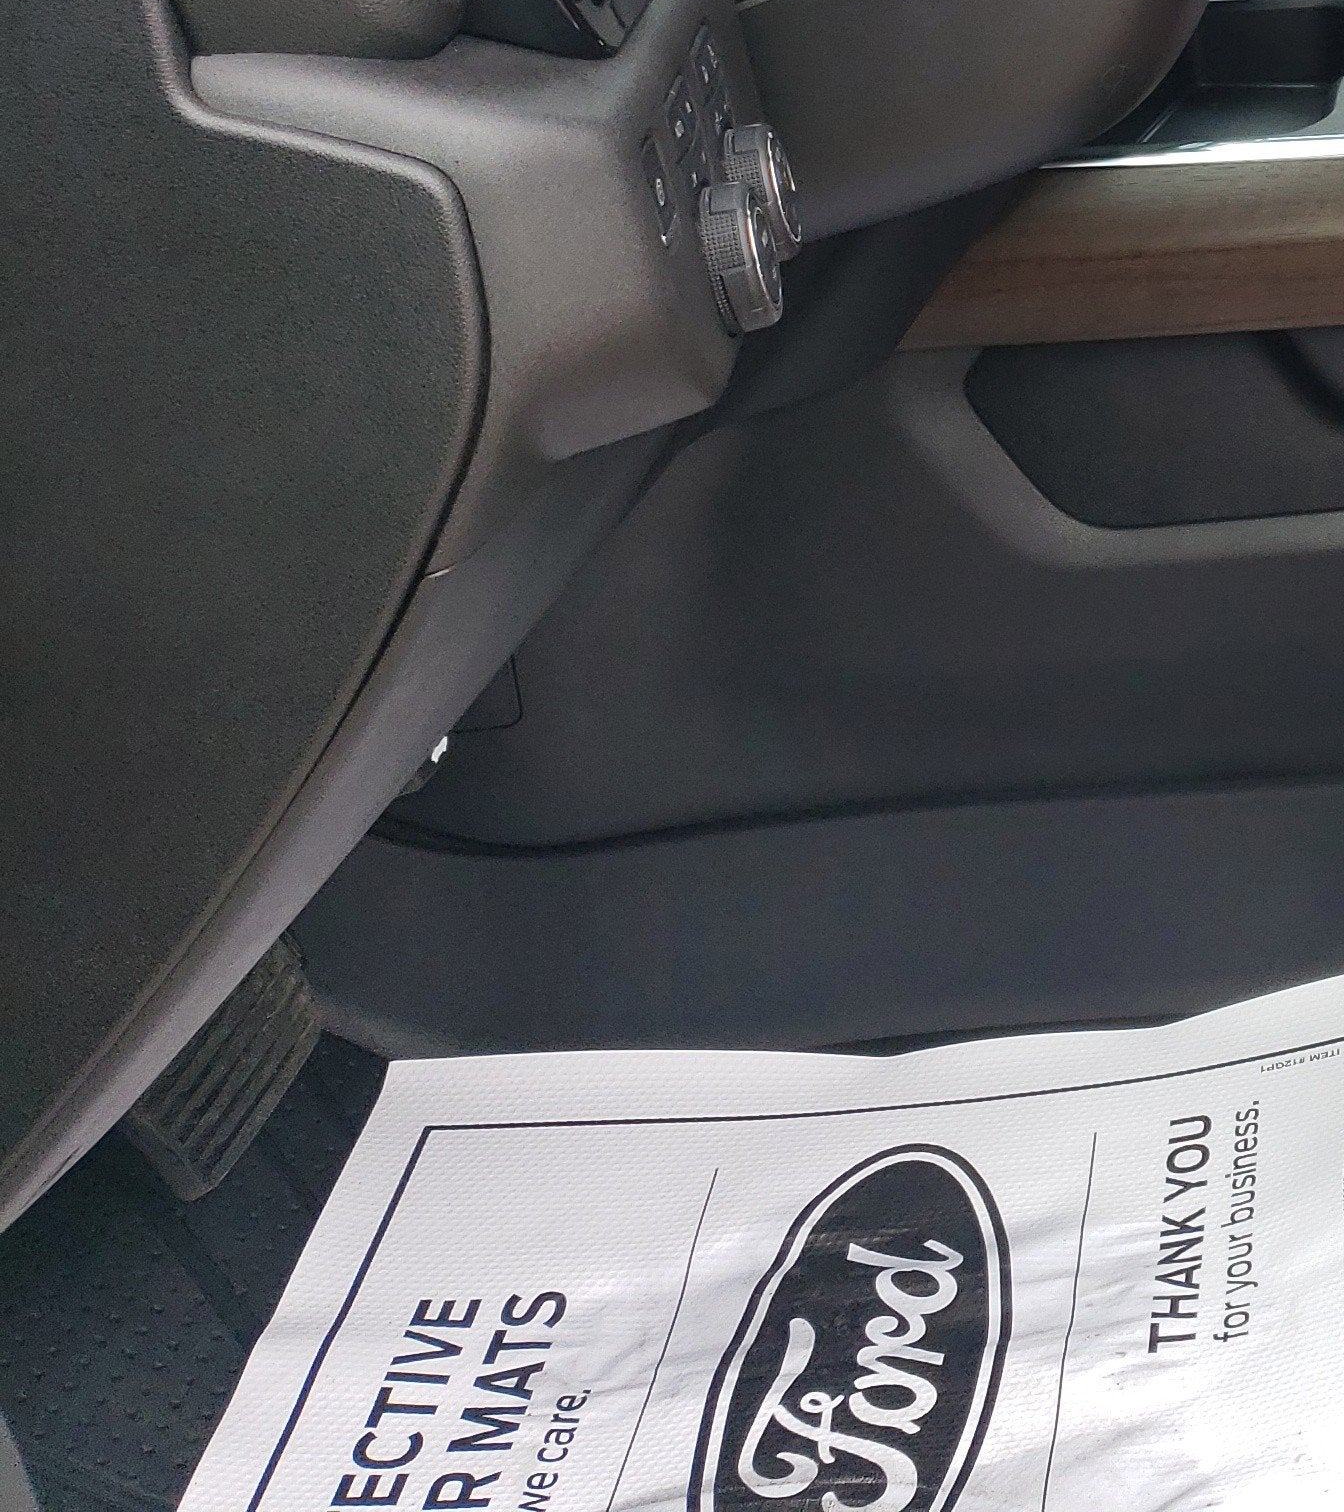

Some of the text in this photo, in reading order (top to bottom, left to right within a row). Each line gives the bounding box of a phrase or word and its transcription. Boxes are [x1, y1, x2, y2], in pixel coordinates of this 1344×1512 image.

[1309, 1048, 1340, 1062] ITEM
[1148, 1114, 1212, 1354] THANK YOU
[1213, 1100, 1259, 1343] for your business.
[327, 1299, 482, 1512] ECTIVE
[446, 1291, 567, 1453] MATS
[537, 1389, 591, 1462] care.
[737, 1239, 964, 1512] Ford
